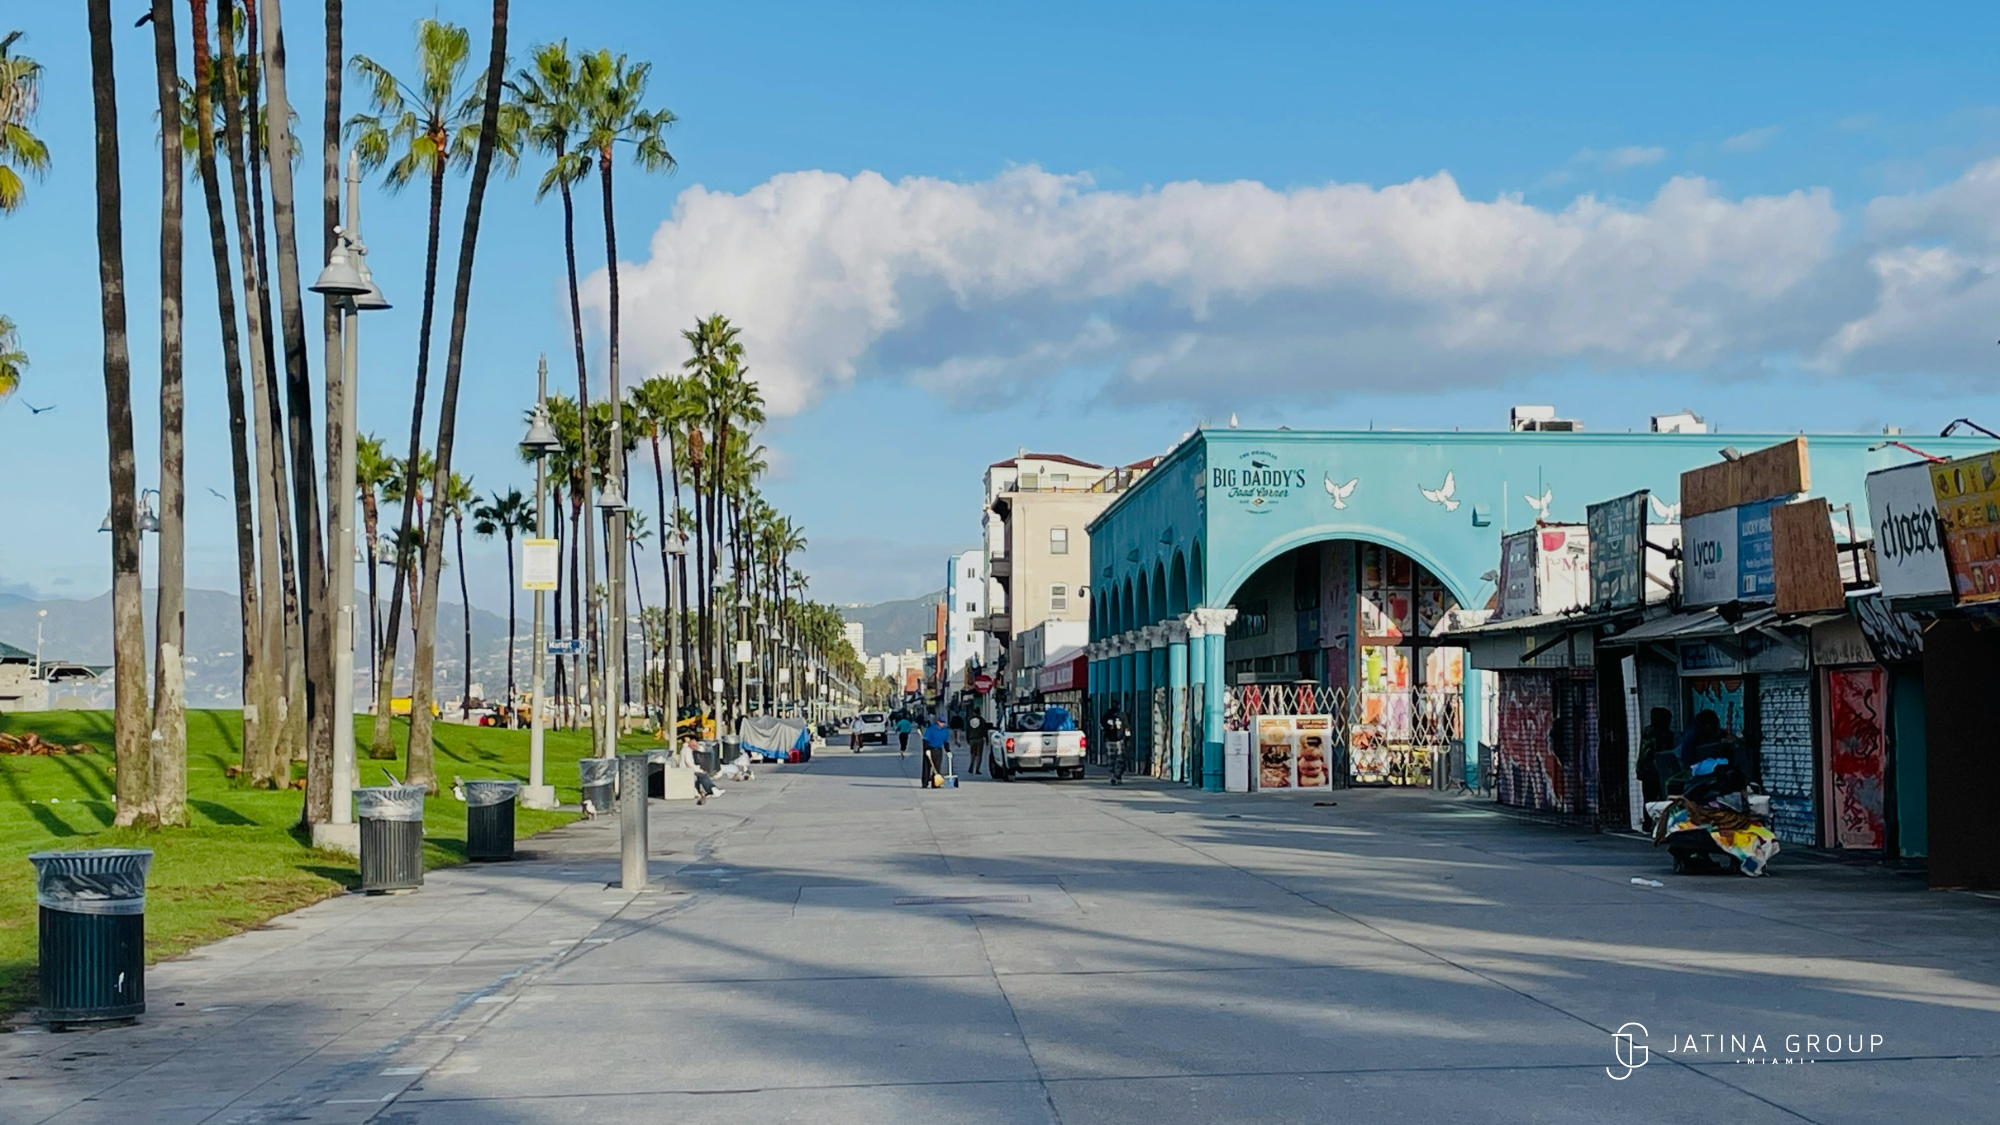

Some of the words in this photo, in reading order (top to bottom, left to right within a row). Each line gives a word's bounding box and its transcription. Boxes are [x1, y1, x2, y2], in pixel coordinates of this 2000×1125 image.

[1213, 467, 1237, 488] BIG
[1243, 469, 1306, 488] DADDY'S
[1228, 487, 1256, 498] Food
[1257, 487, 1289, 498] Corner
[1693, 537, 1716, 573] Lyco
